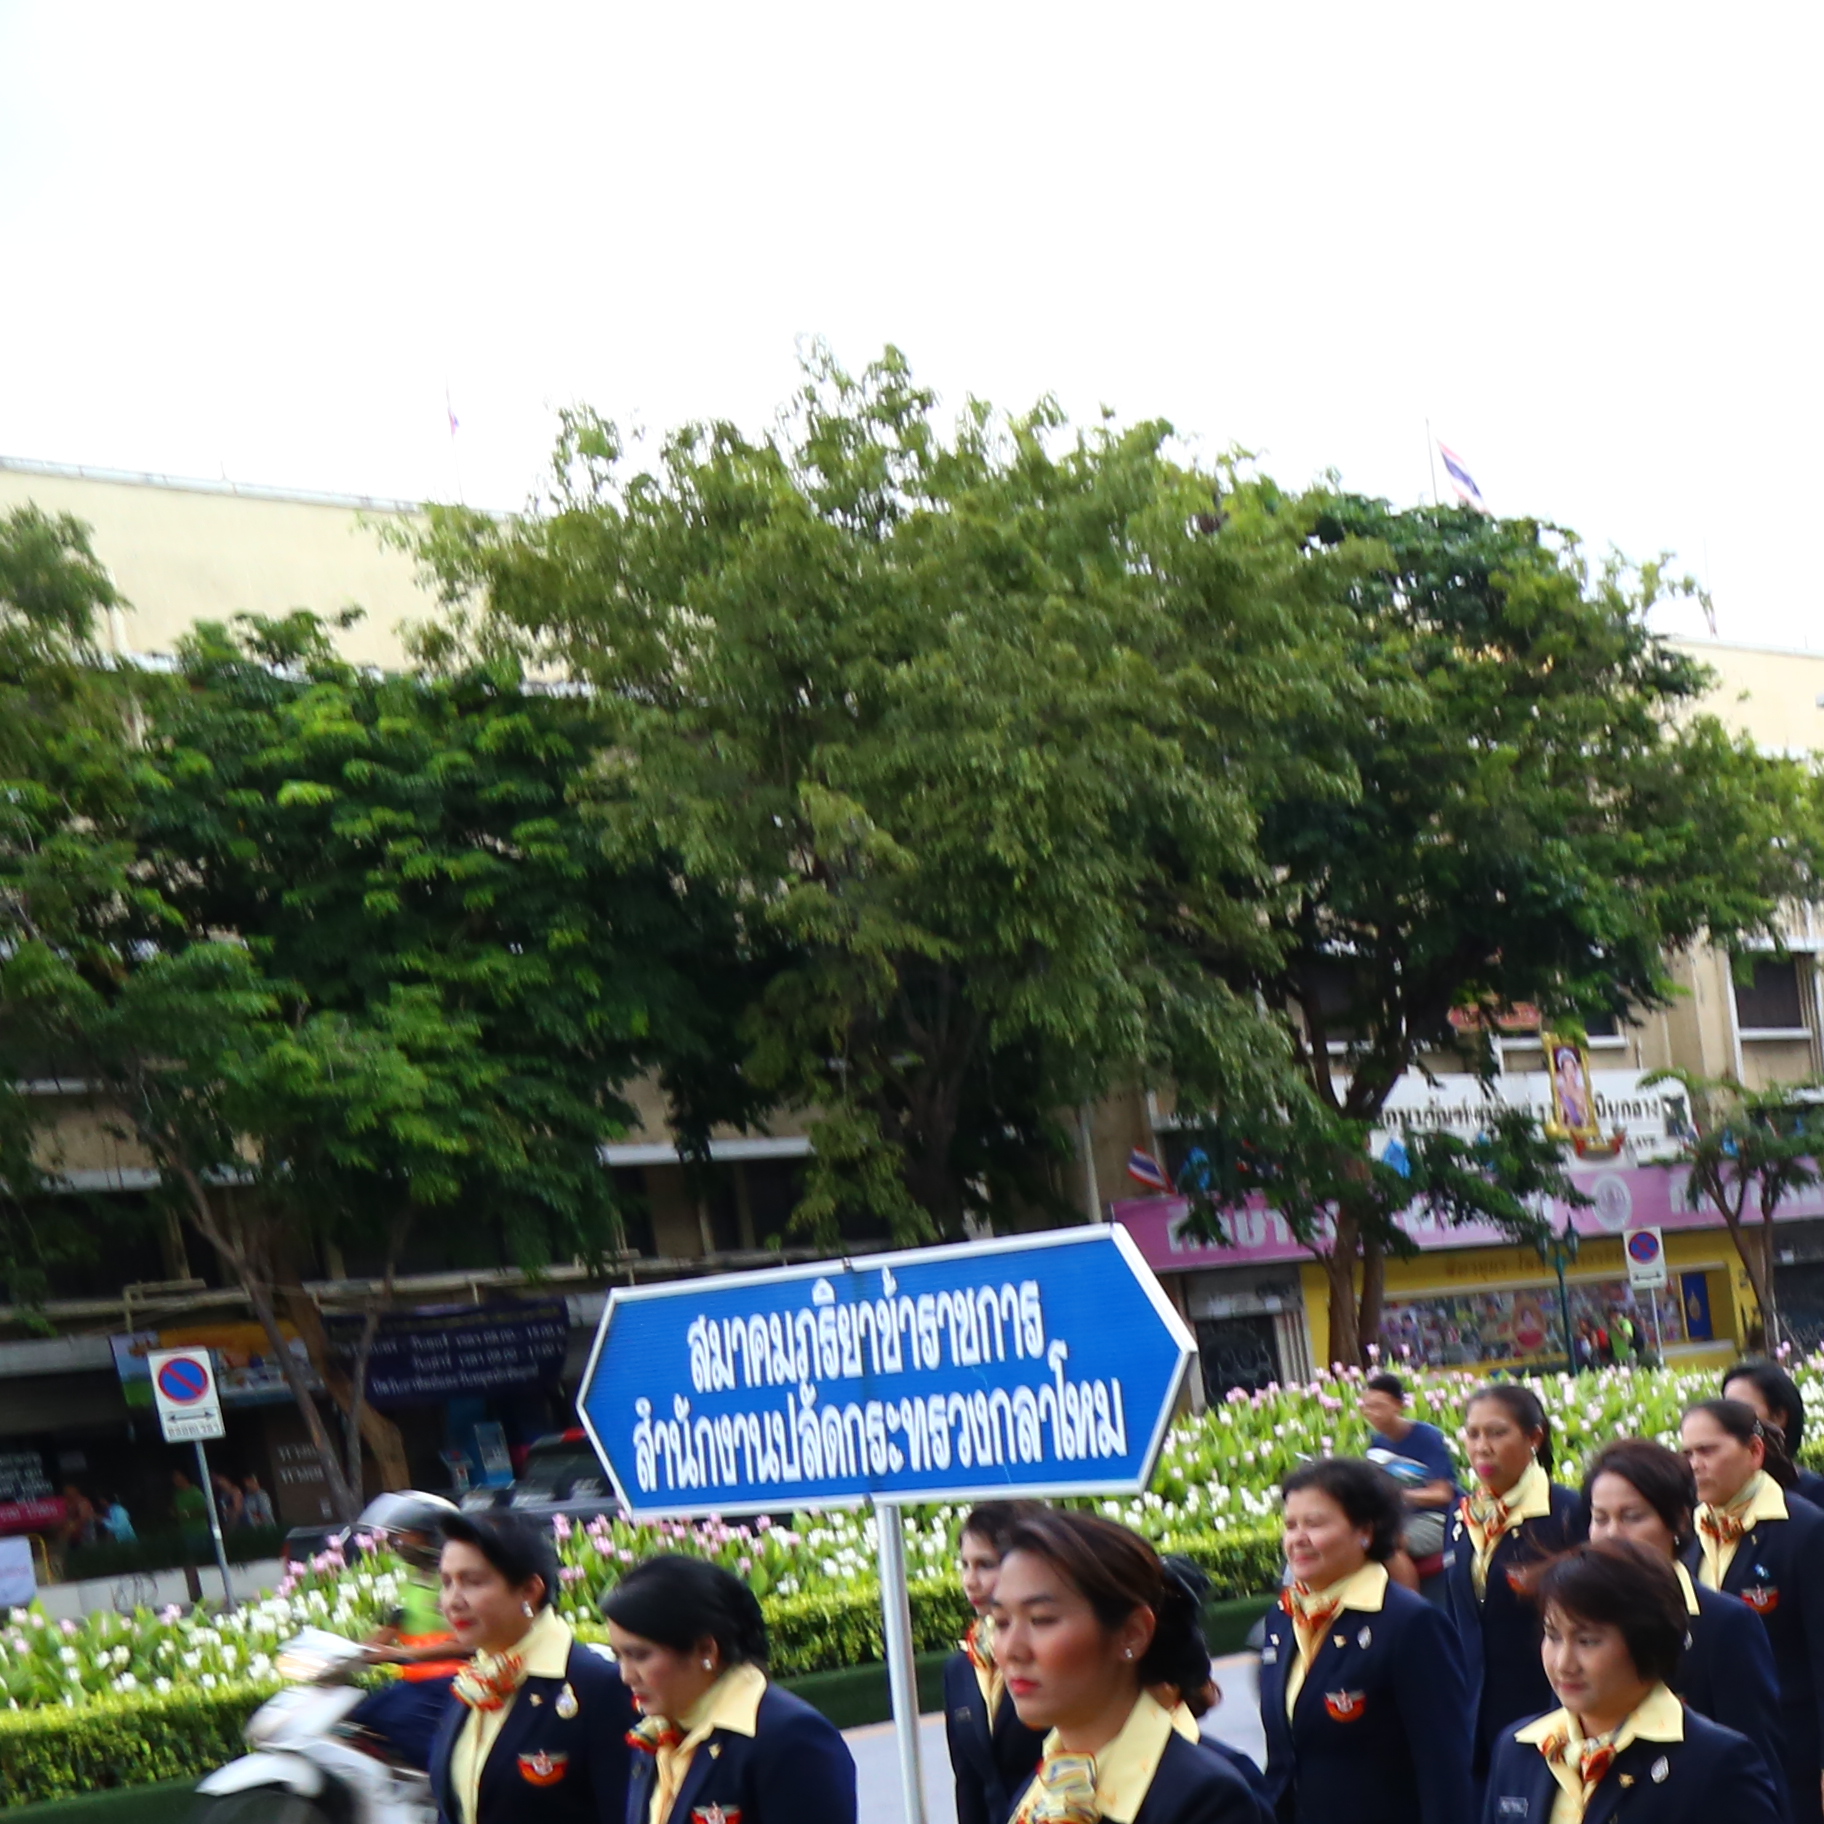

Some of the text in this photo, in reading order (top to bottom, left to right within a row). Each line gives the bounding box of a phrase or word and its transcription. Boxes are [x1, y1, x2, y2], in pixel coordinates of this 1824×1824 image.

[686, 1266, 1045, 1394] สมาคมภริยาข้าราชการ
[634, 1341, 1126, 1493] สำนักงานปลัดกระทรวงกลาโหม
